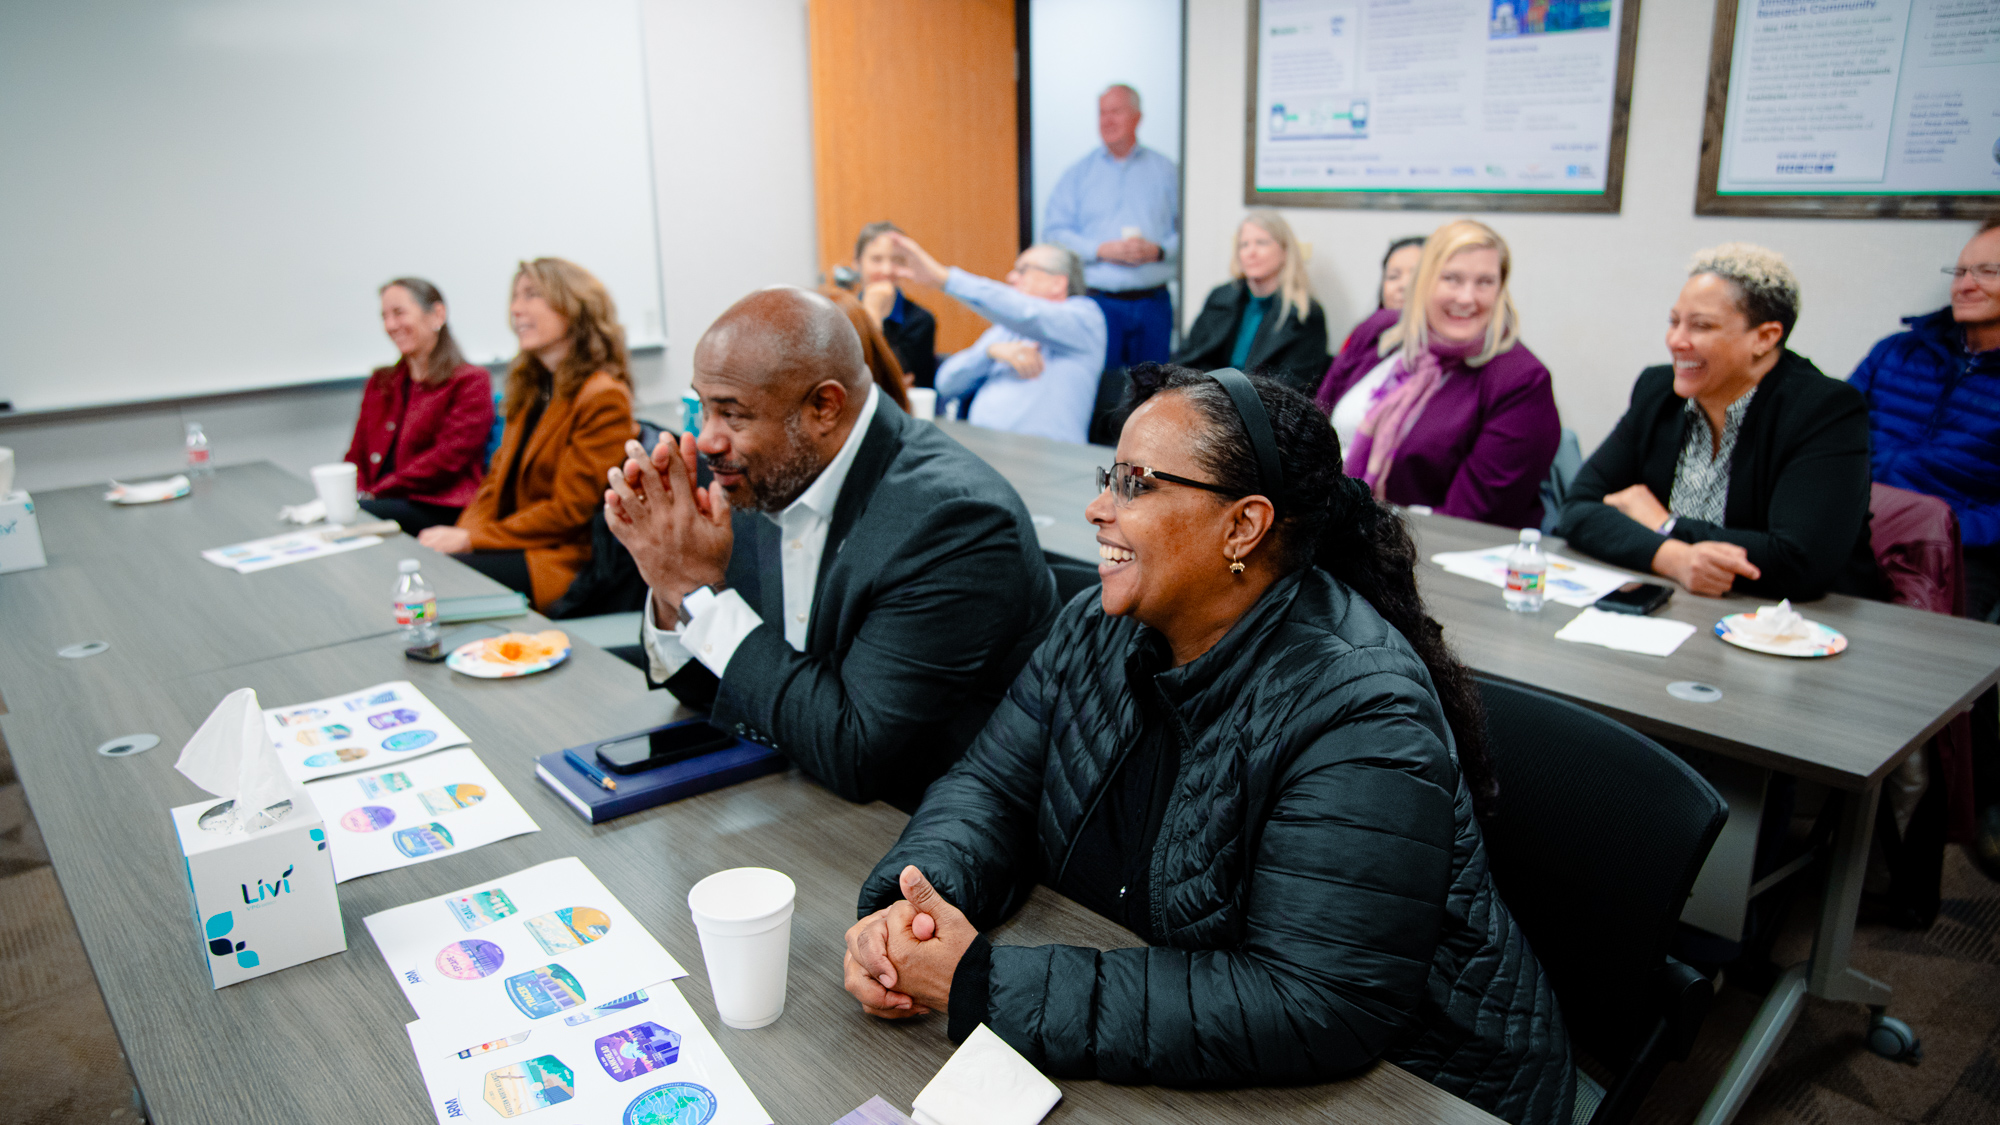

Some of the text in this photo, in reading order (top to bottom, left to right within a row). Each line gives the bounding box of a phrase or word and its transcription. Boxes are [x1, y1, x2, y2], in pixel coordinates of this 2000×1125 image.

[1757, 0, 1876, 18] Research Community
[461, 905, 476, 919] SAIL
[447, 956, 462, 971] EPCAPE
[405, 970, 420, 984] ARM
[517, 985, 537, 1007] TRACER
[601, 1045, 622, 1073] BANKHEAD
[491, 1072, 514, 1115] EASTERN NORTH ATLANTIC
[444, 1098, 461, 1117] ARM
